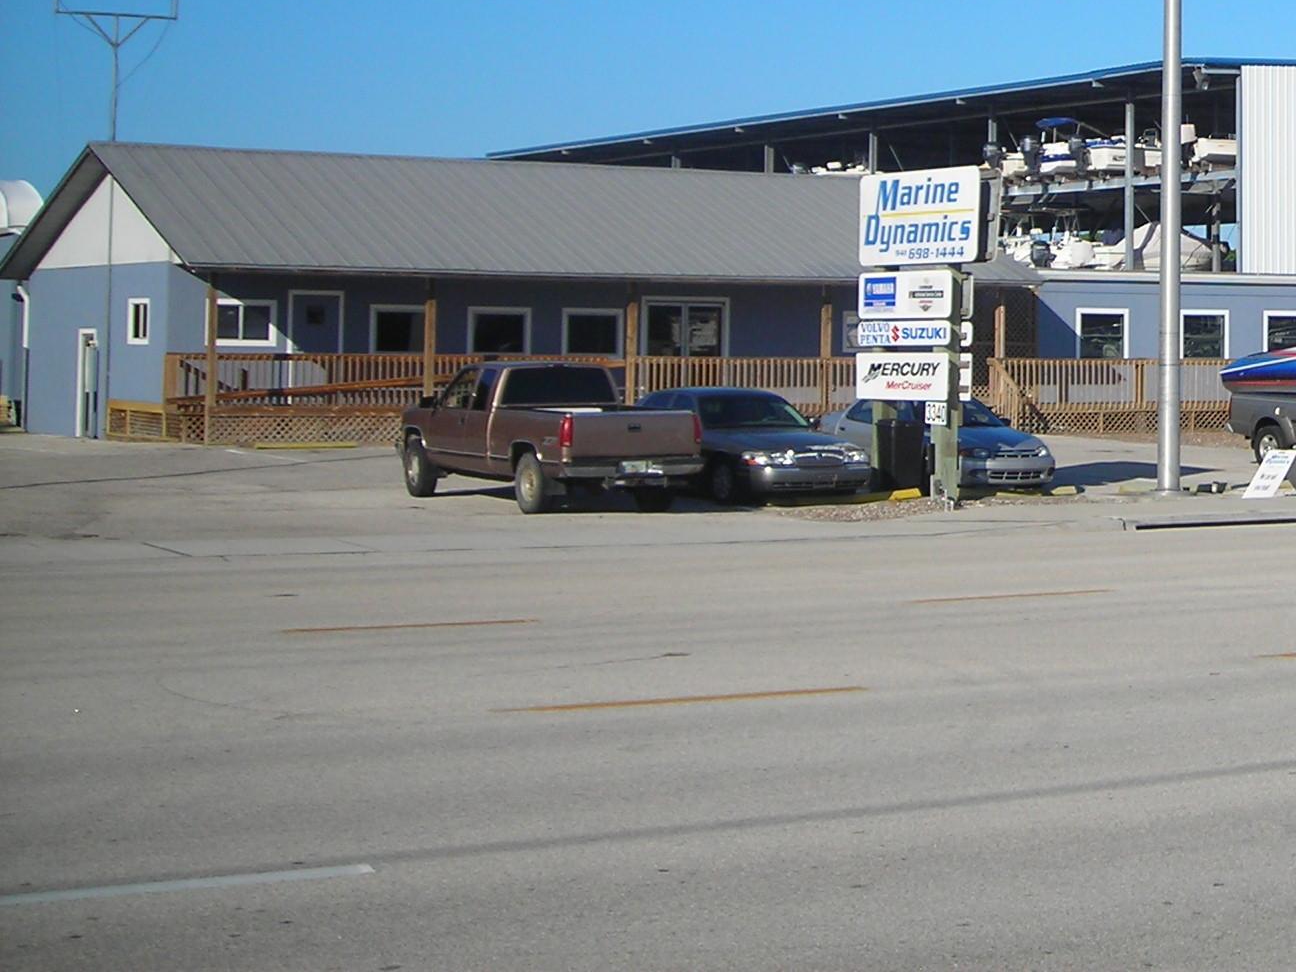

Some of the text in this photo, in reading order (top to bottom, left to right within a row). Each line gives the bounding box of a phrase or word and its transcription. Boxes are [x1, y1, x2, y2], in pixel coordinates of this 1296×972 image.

[877, 177, 959, 211] Marine
[864, 214, 972, 252] Dynamics
[908, 246, 964, 259] 698-1444
[860, 323, 890, 333] VOLVO
[901, 327, 947, 339] SUZUKI
[860, 334, 891, 344] PENTA
[867, 362, 940, 377] MERCURY
[885, 381, 932, 390] MerCruiser
[927, 403, 946, 423] 3340
